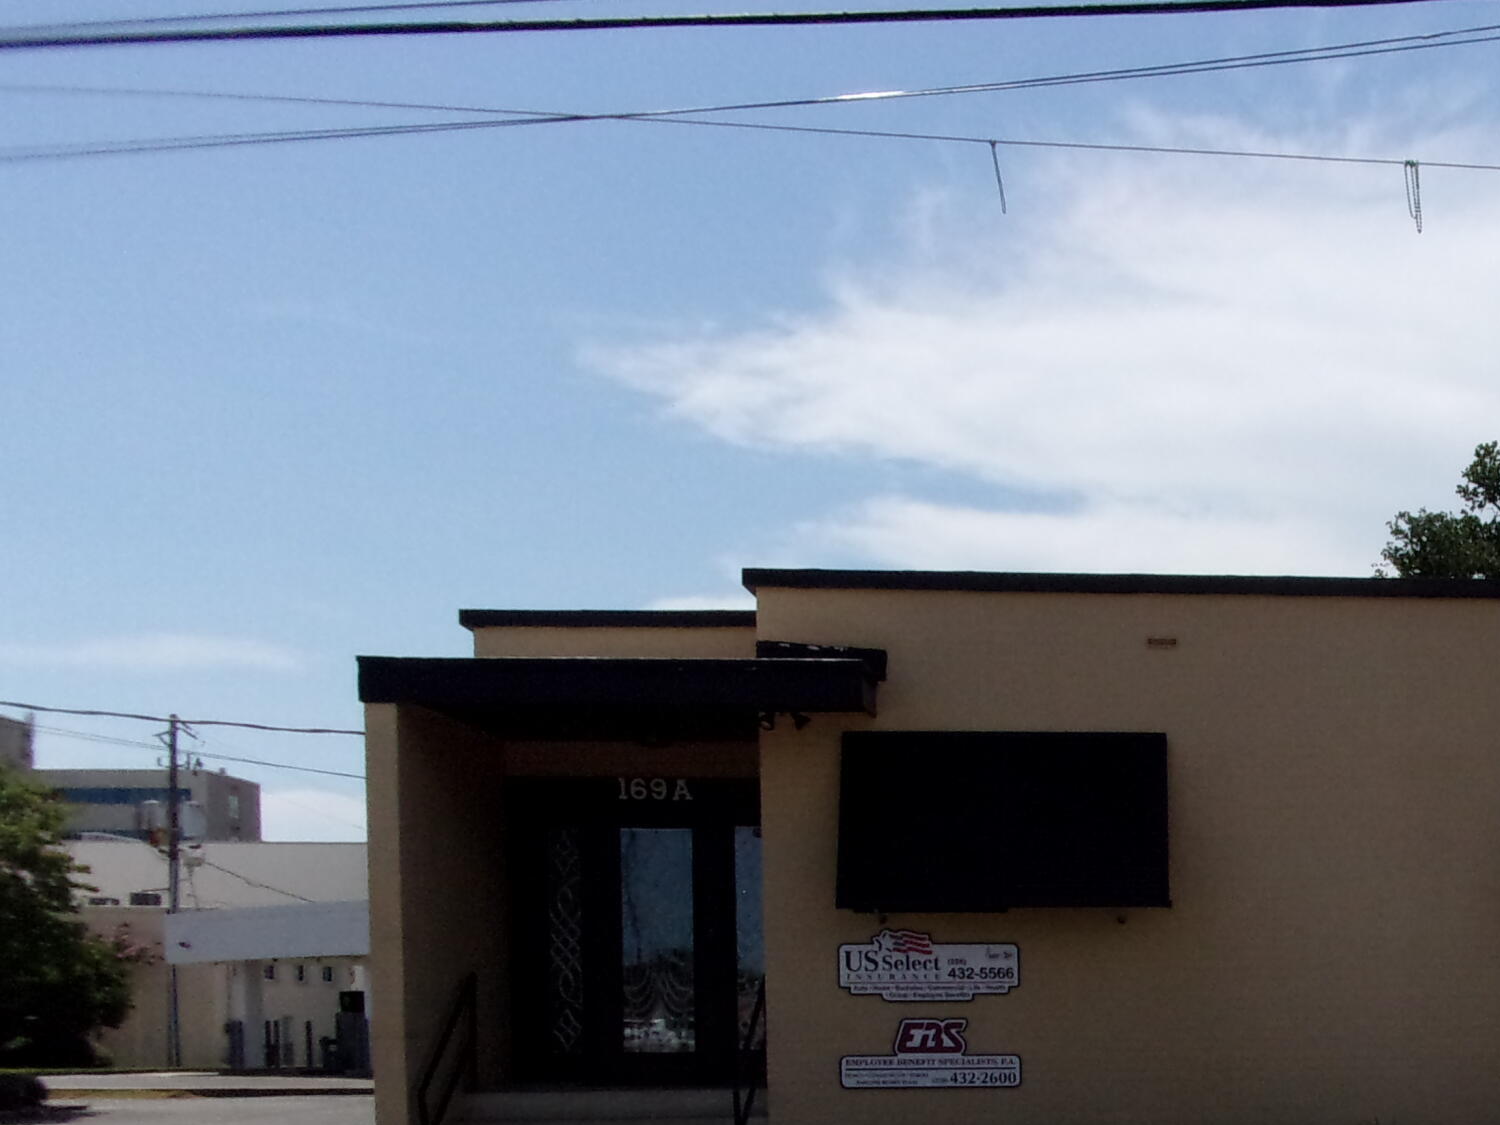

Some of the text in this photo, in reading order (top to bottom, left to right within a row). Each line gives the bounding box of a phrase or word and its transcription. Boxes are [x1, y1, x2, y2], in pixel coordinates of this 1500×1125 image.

[847, 973, 941, 981] INSURANCE
[947, 967, 1015, 980] 432-5566
[897, 1058, 936, 1066] BENEFIT
